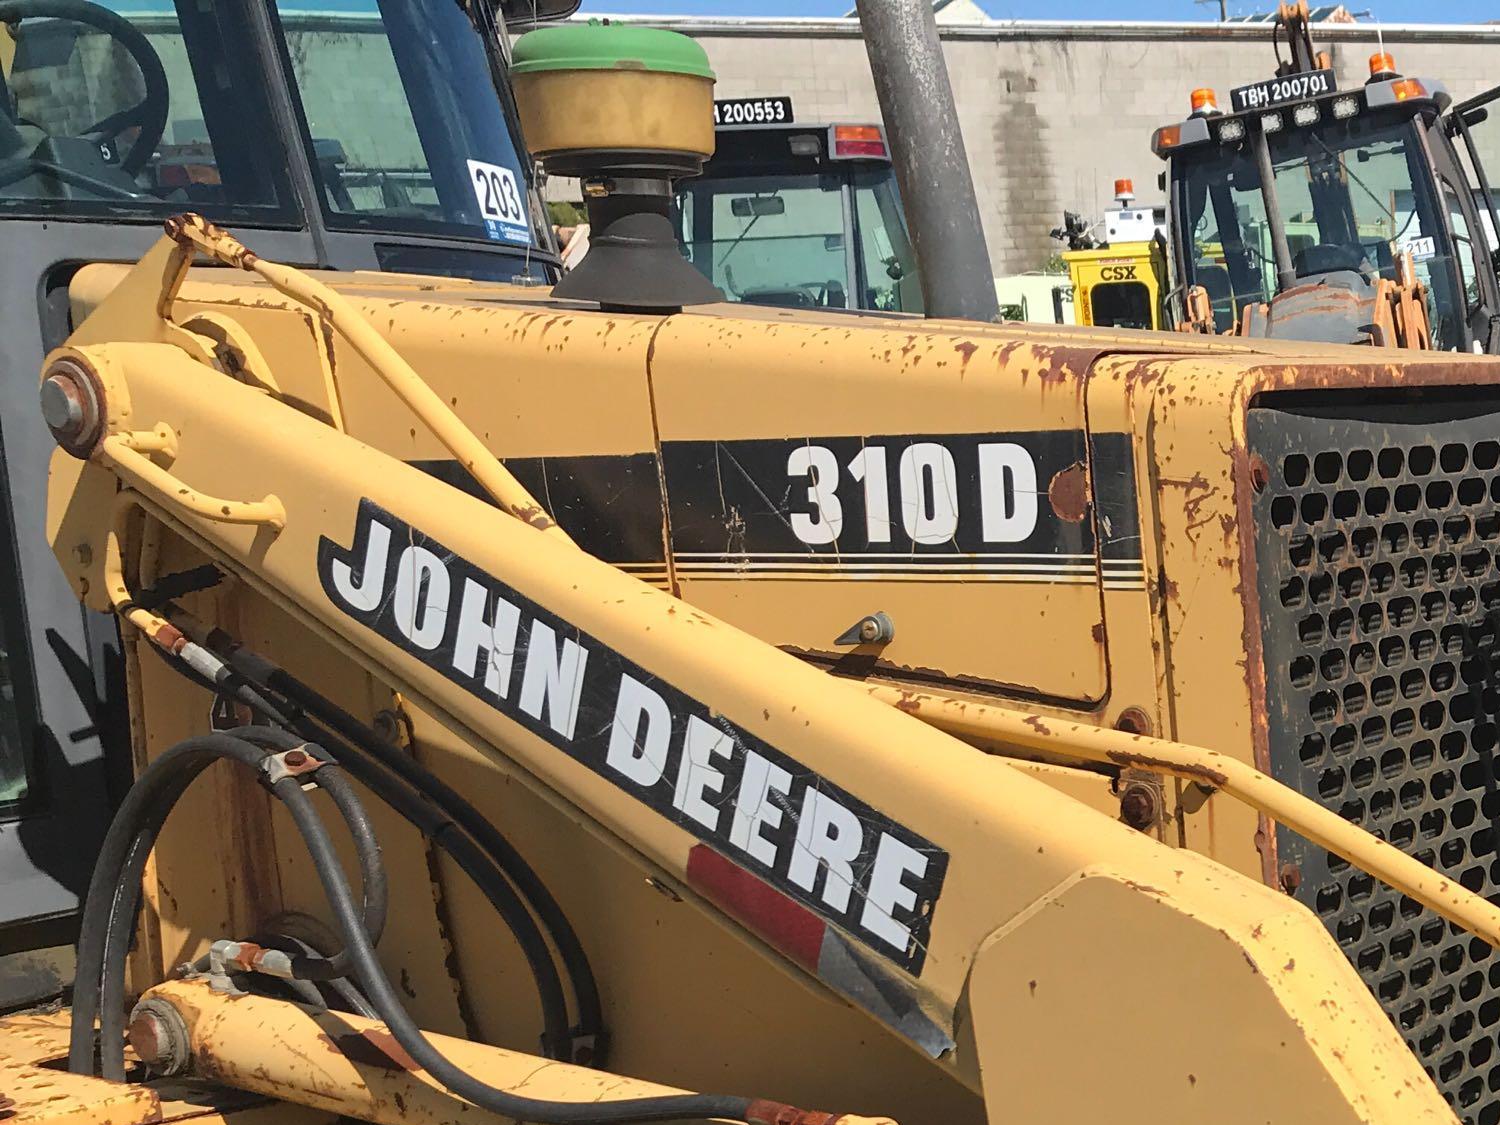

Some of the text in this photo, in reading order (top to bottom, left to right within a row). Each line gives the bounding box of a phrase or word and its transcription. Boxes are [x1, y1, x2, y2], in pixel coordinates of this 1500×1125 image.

[723, 101, 785, 122] 200553
[1239, 75, 1328, 107] TBH 200701
[476, 168, 520, 221] 203
[1101, 266, 1137, 281] CSX
[787, 442, 1039, 545] 310 D
[332, 518, 930, 953] JOHN DEERE
